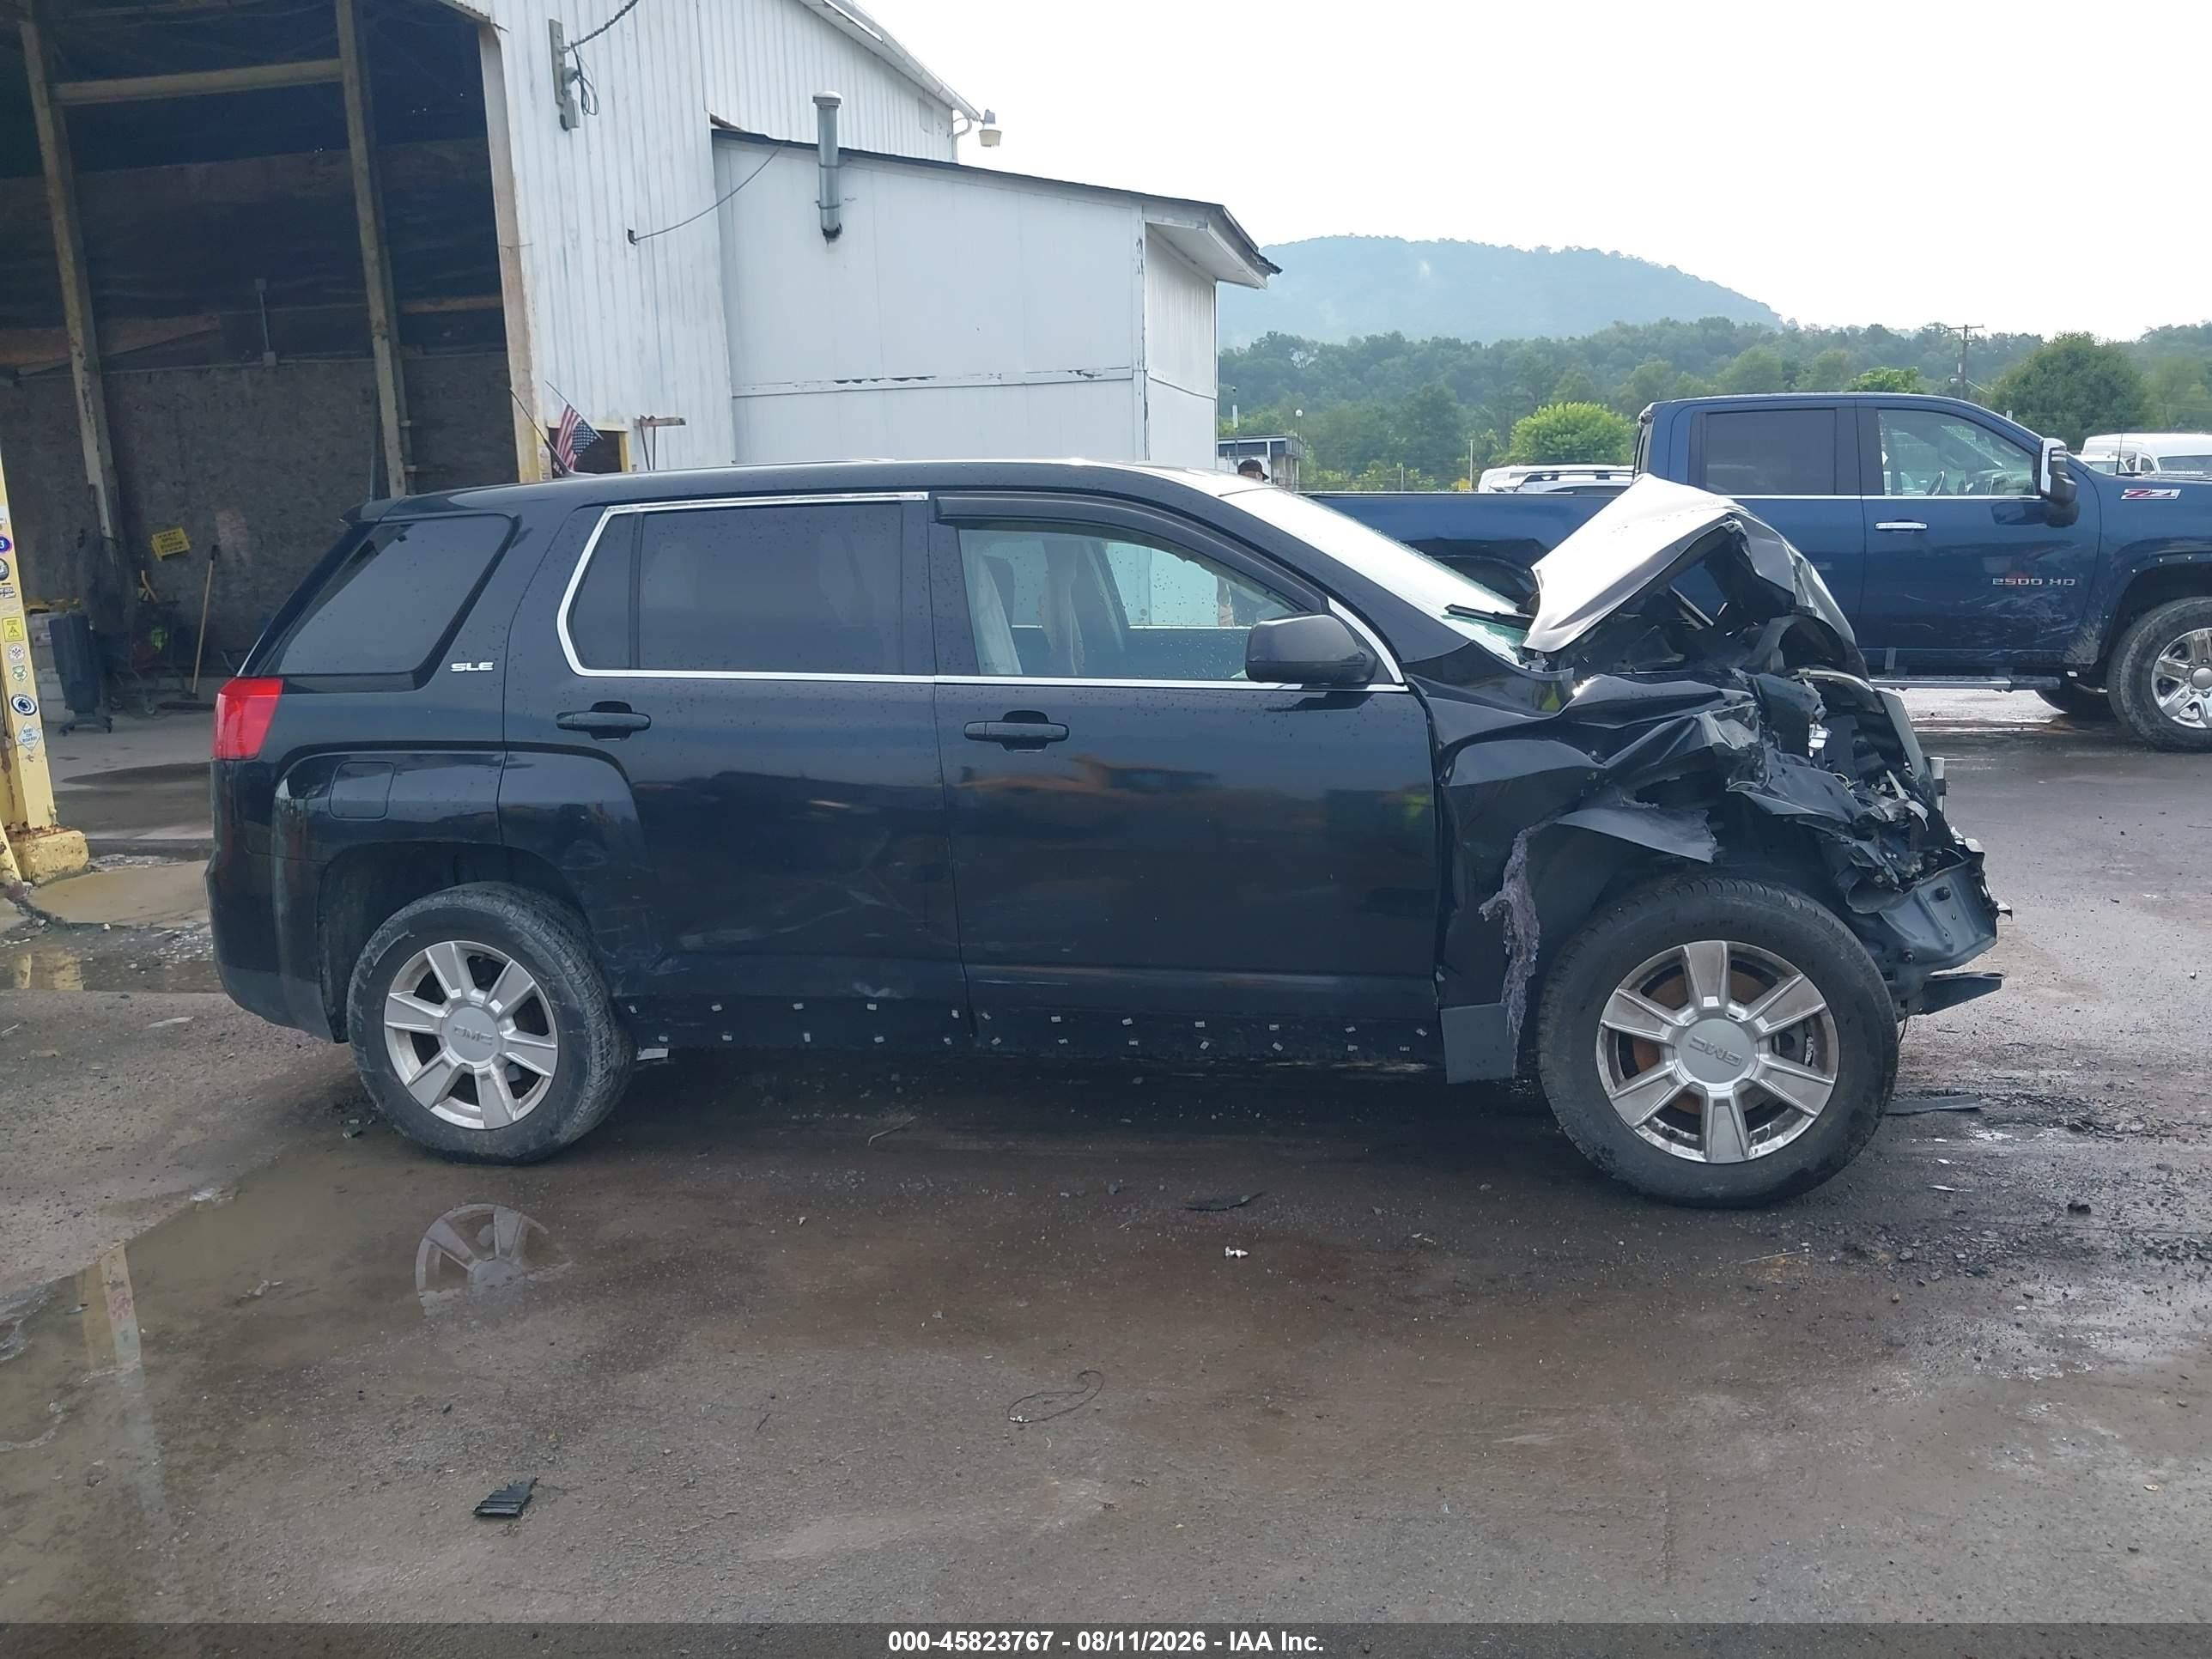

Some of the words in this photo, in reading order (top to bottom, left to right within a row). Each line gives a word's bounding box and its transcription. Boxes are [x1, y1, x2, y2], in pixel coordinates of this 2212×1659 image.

[2049, 578, 2076, 586] HD
[451, 661, 495, 672] SLE
[453, 1024, 494, 1046] GMC
[1689, 1036, 1742, 1066] GMC
